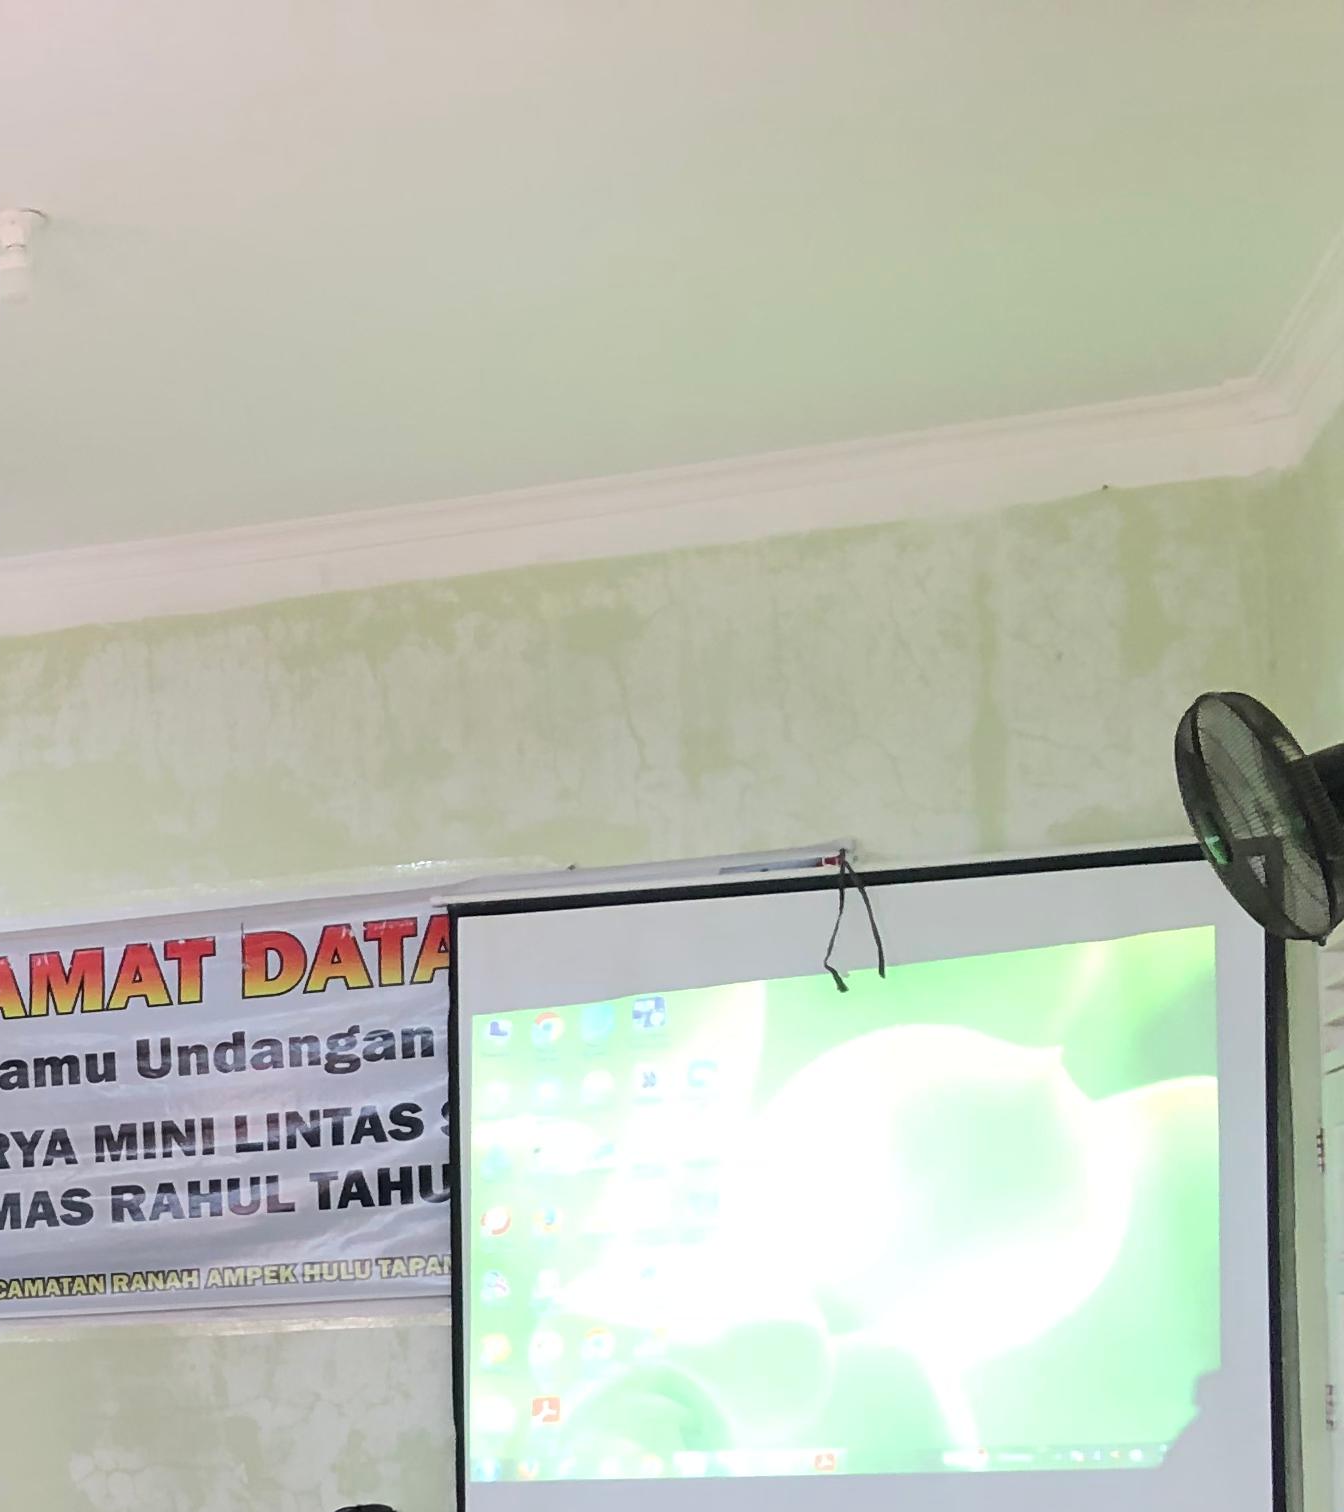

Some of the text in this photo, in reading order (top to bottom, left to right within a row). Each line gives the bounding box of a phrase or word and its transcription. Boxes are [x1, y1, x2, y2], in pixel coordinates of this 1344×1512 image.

[242, 914, 450, 999] DATA
[136, 1025, 434, 1079] Undangan
[94, 1117, 216, 1162] MINI
[235, 1102, 424, 1153] LINTAS
[111, 1175, 295, 1223] RAHUL
[309, 1163, 451, 1211] TAHU
[111, 1268, 200, 1294] RANAH
[205, 1262, 299, 1289] AMPEK
[302, 1258, 372, 1284] HULU
